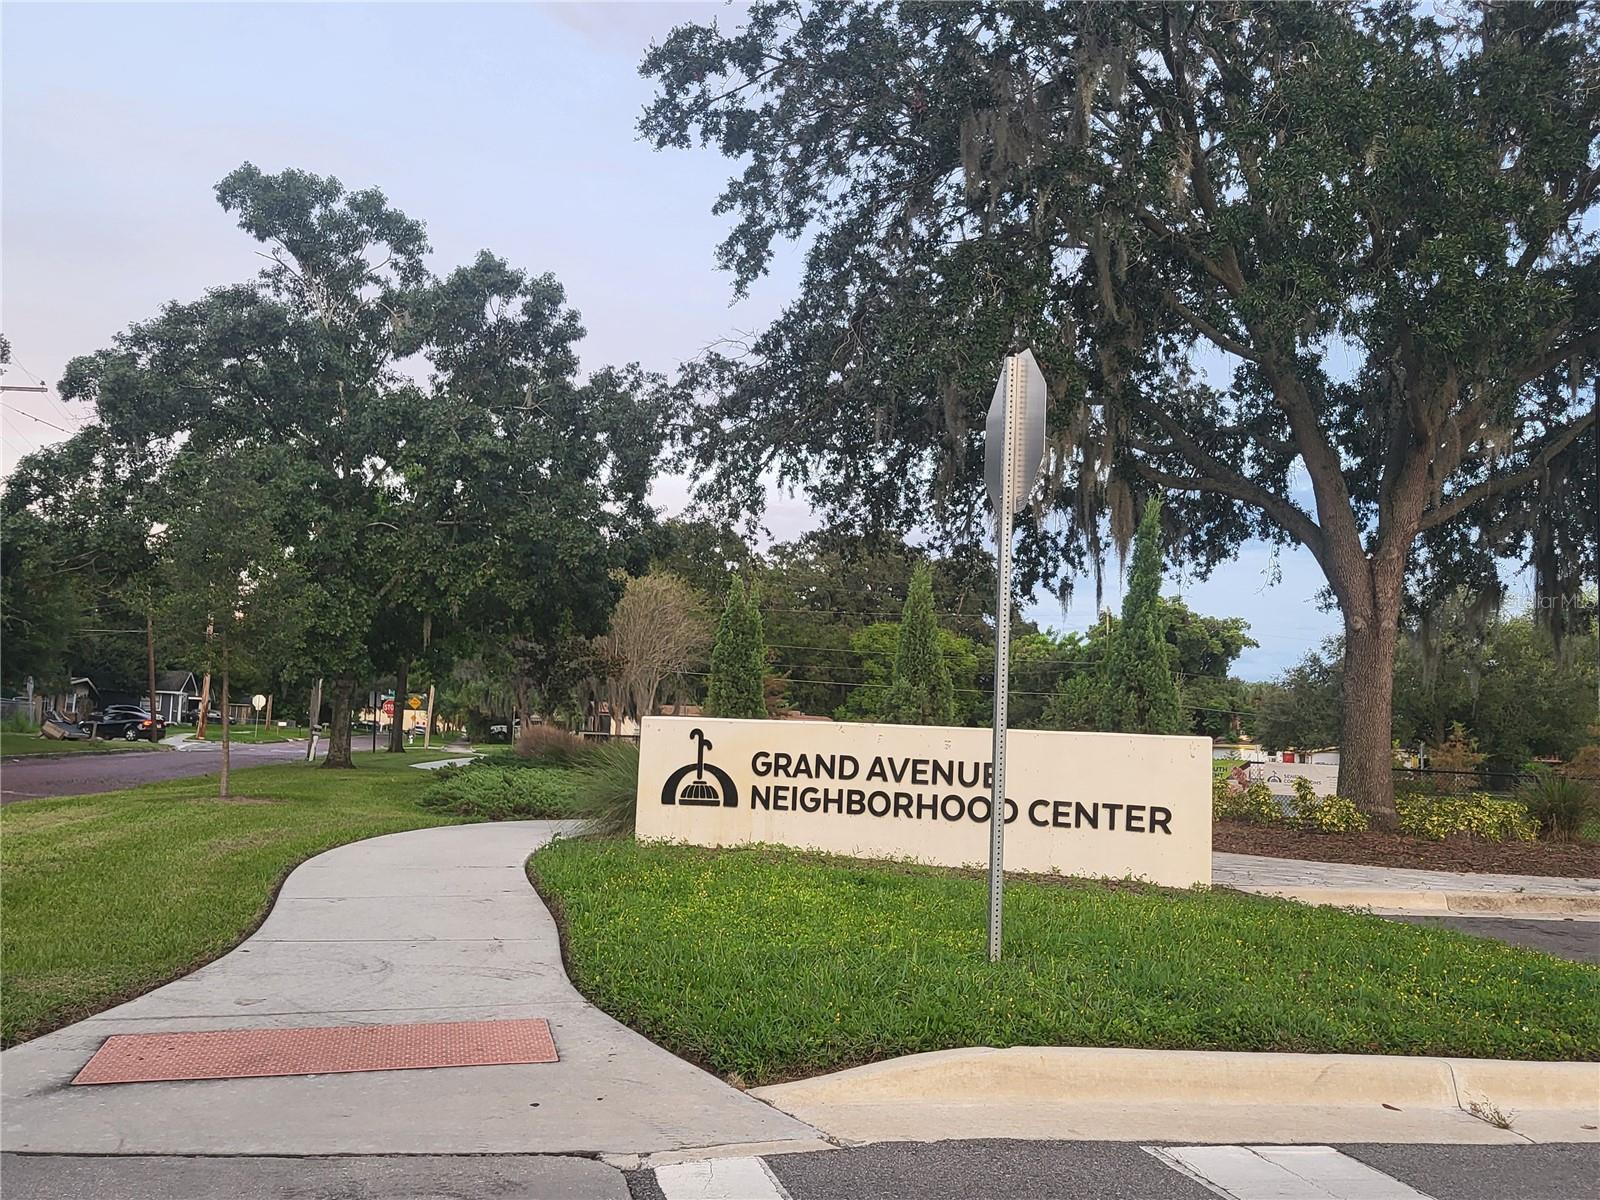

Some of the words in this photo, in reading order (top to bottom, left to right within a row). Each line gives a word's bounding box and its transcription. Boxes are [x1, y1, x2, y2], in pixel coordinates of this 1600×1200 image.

[751, 751, 860, 781] GRAND
[750, 784, 1019, 825] NEIGHBORHOOD
[1028, 799, 1172, 835] CENTER
